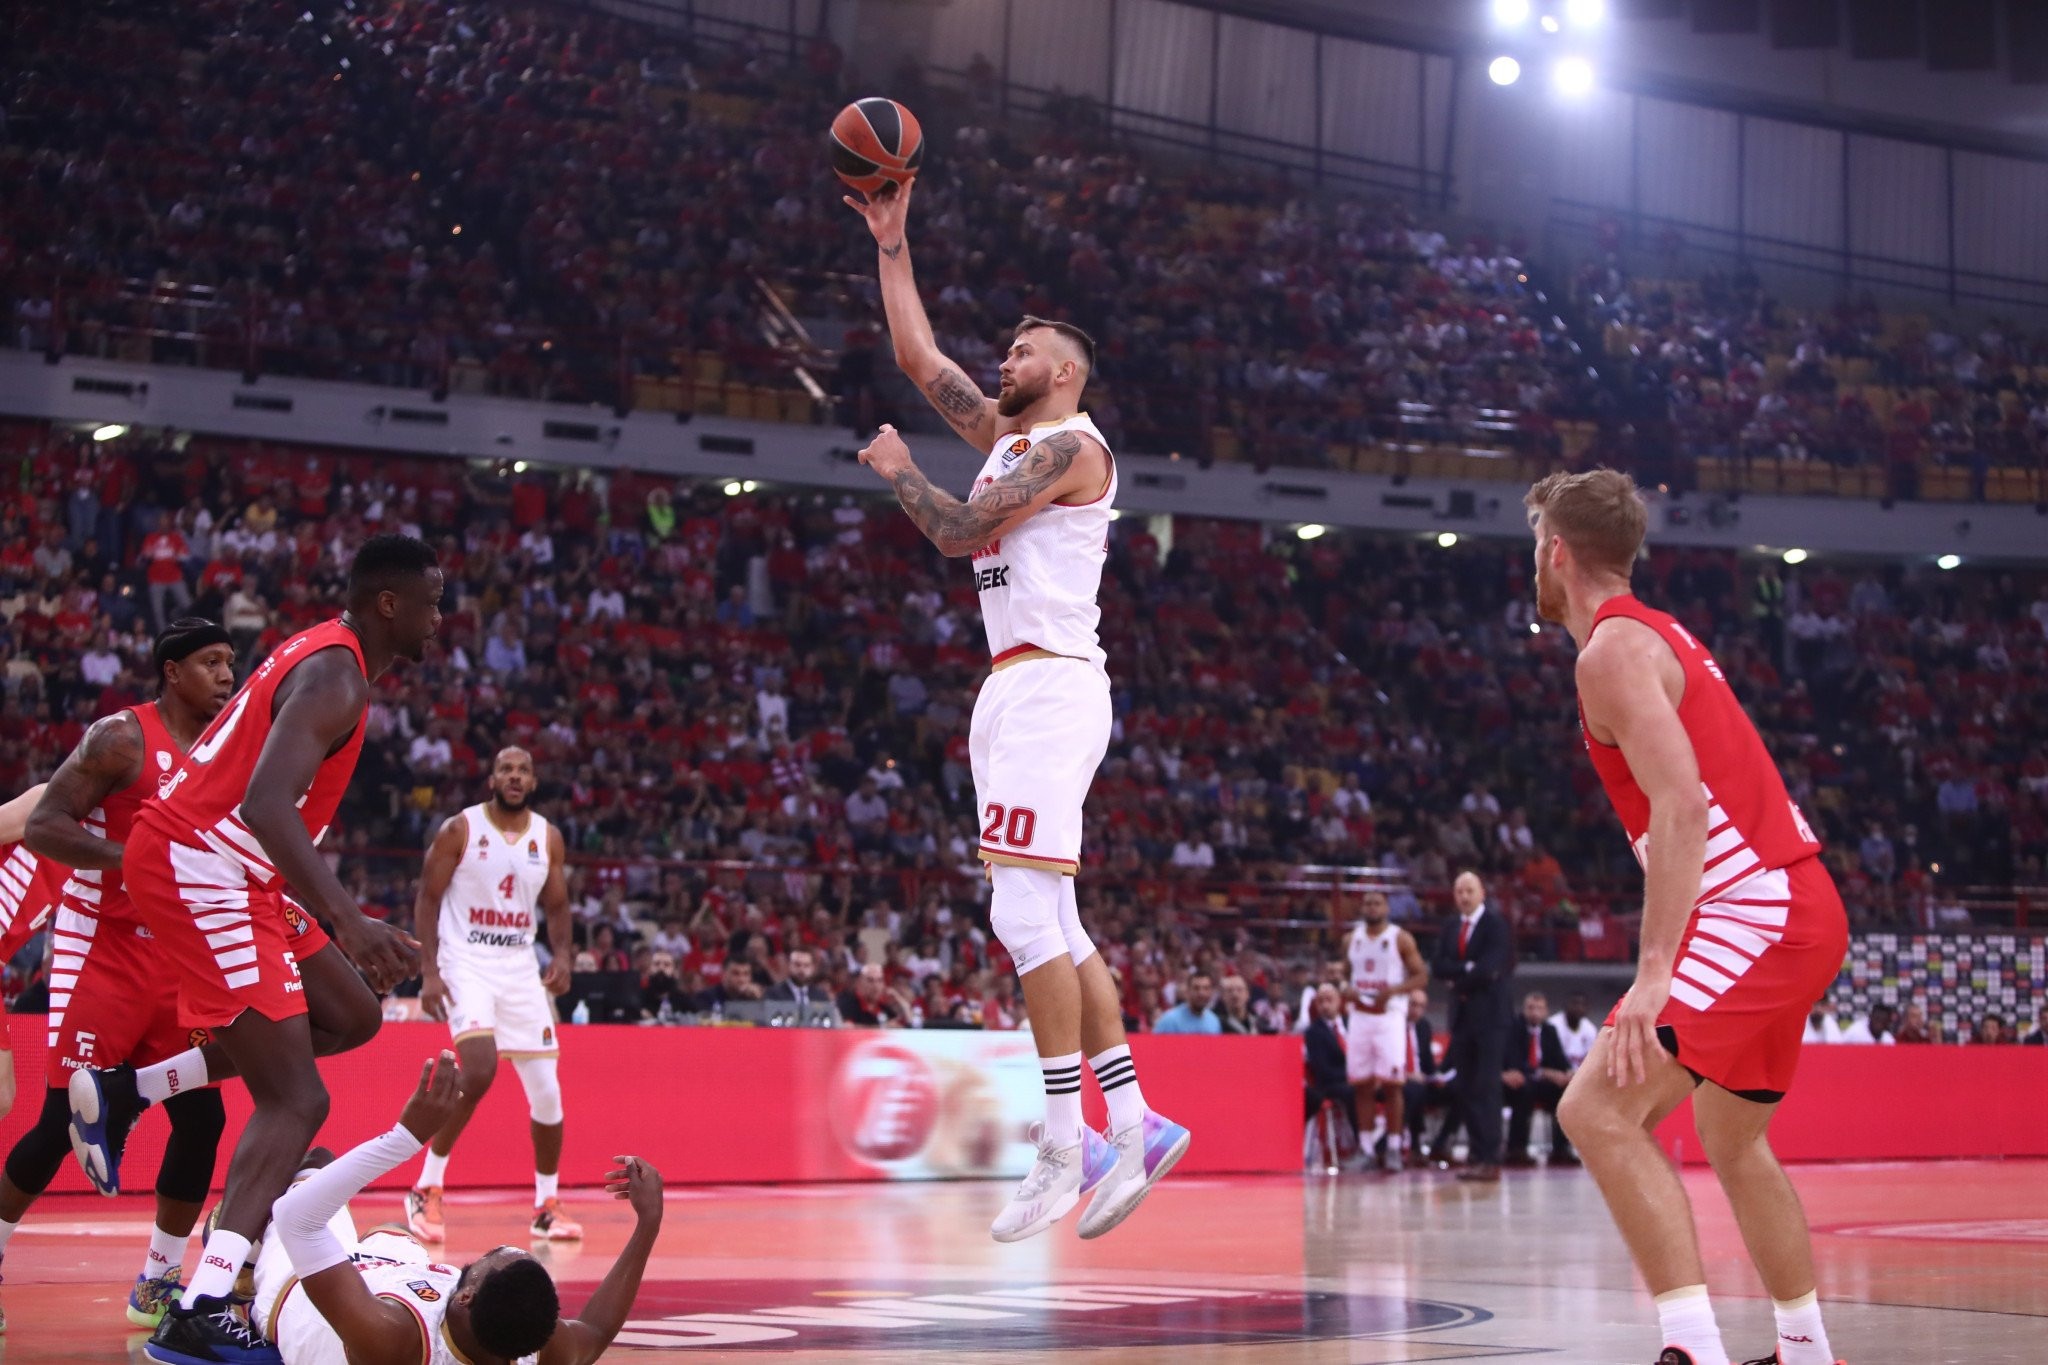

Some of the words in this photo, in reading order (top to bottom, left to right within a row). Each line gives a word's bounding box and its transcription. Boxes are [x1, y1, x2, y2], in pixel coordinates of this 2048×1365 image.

[981, 802, 1037, 849] 20
[498, 872, 515, 899] 4
[166, 1068, 180, 1095] GSA
[149, 1248, 168, 1264] GSA
[205, 1255, 233, 1273] GSA
